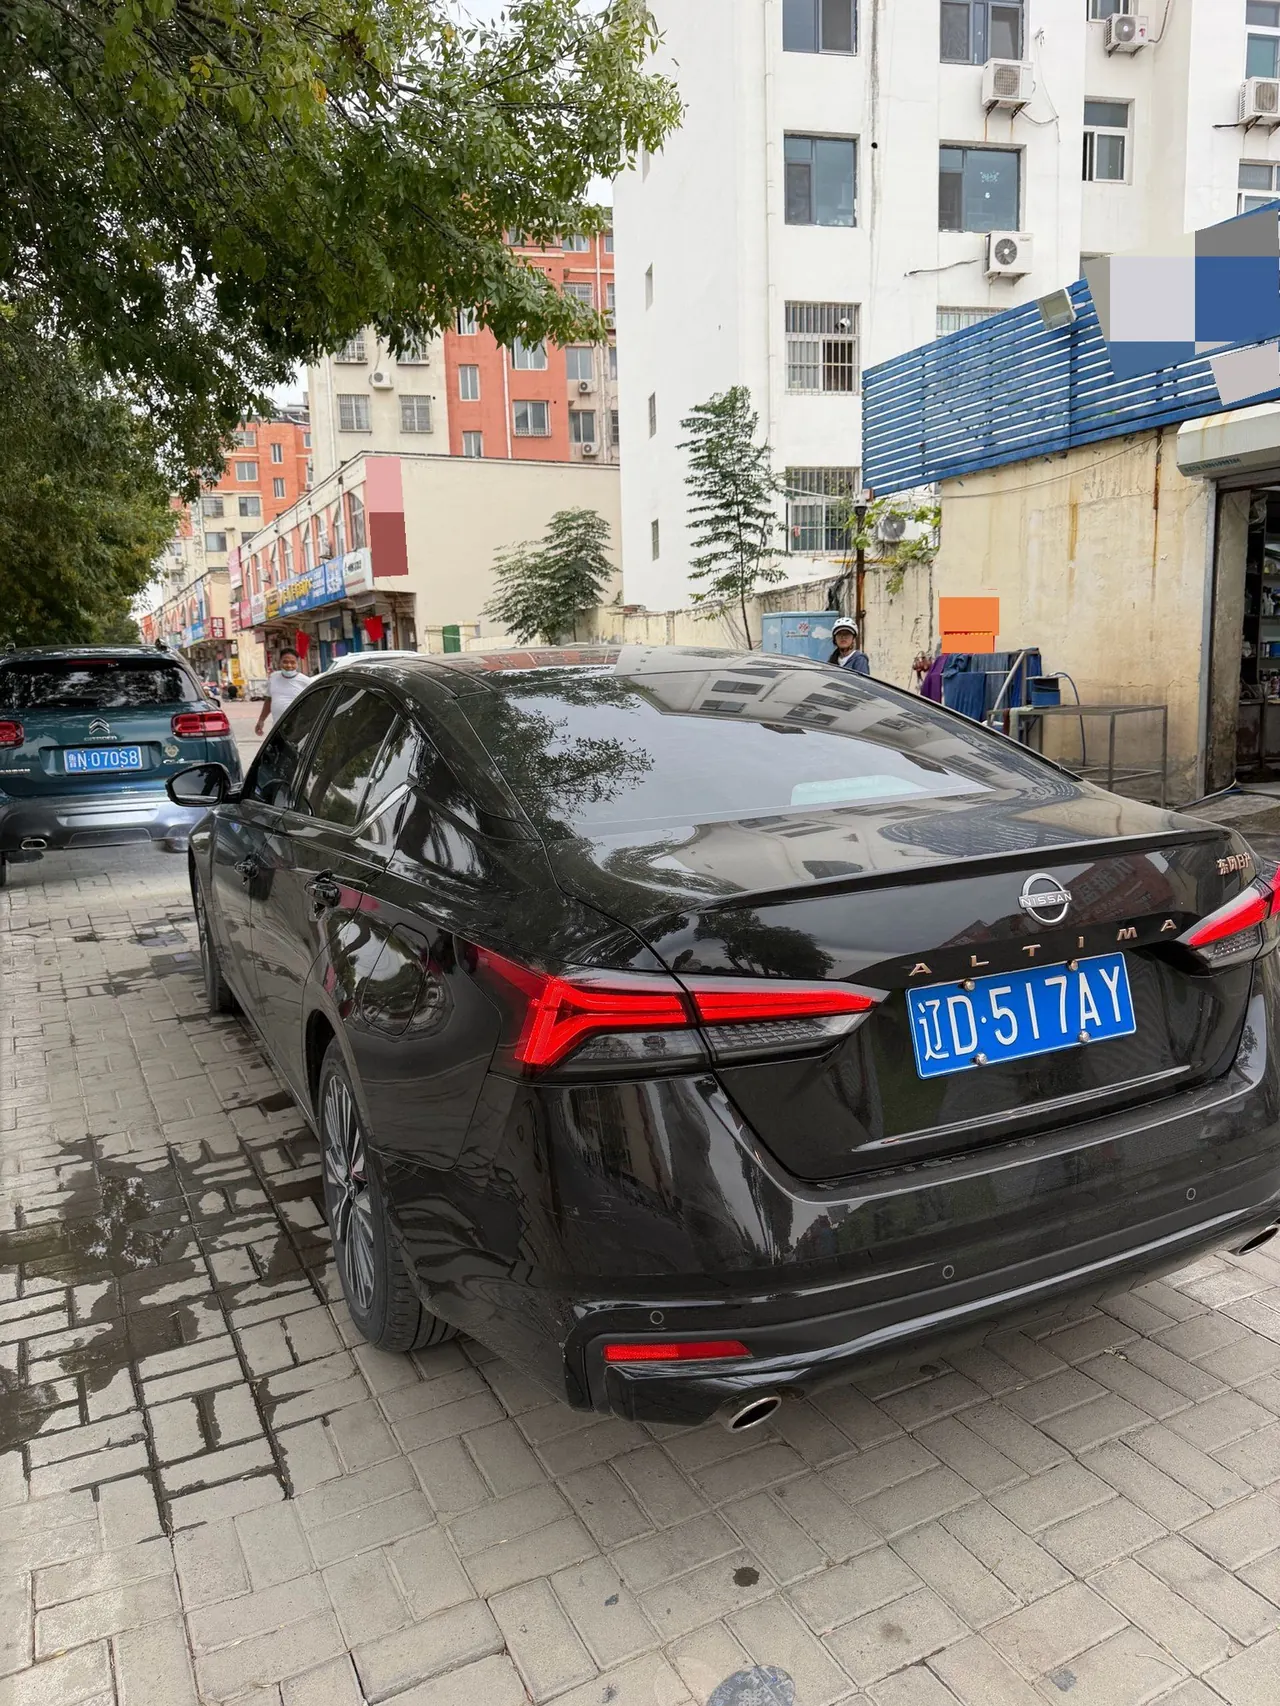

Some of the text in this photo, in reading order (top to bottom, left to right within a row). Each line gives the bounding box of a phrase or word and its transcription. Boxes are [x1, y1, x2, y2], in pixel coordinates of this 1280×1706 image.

[1216, 851, 1252, 875] 东风日产
[1020, 892, 1073, 907] NISSAN
[907, 918, 1178, 977] ALTIMA
